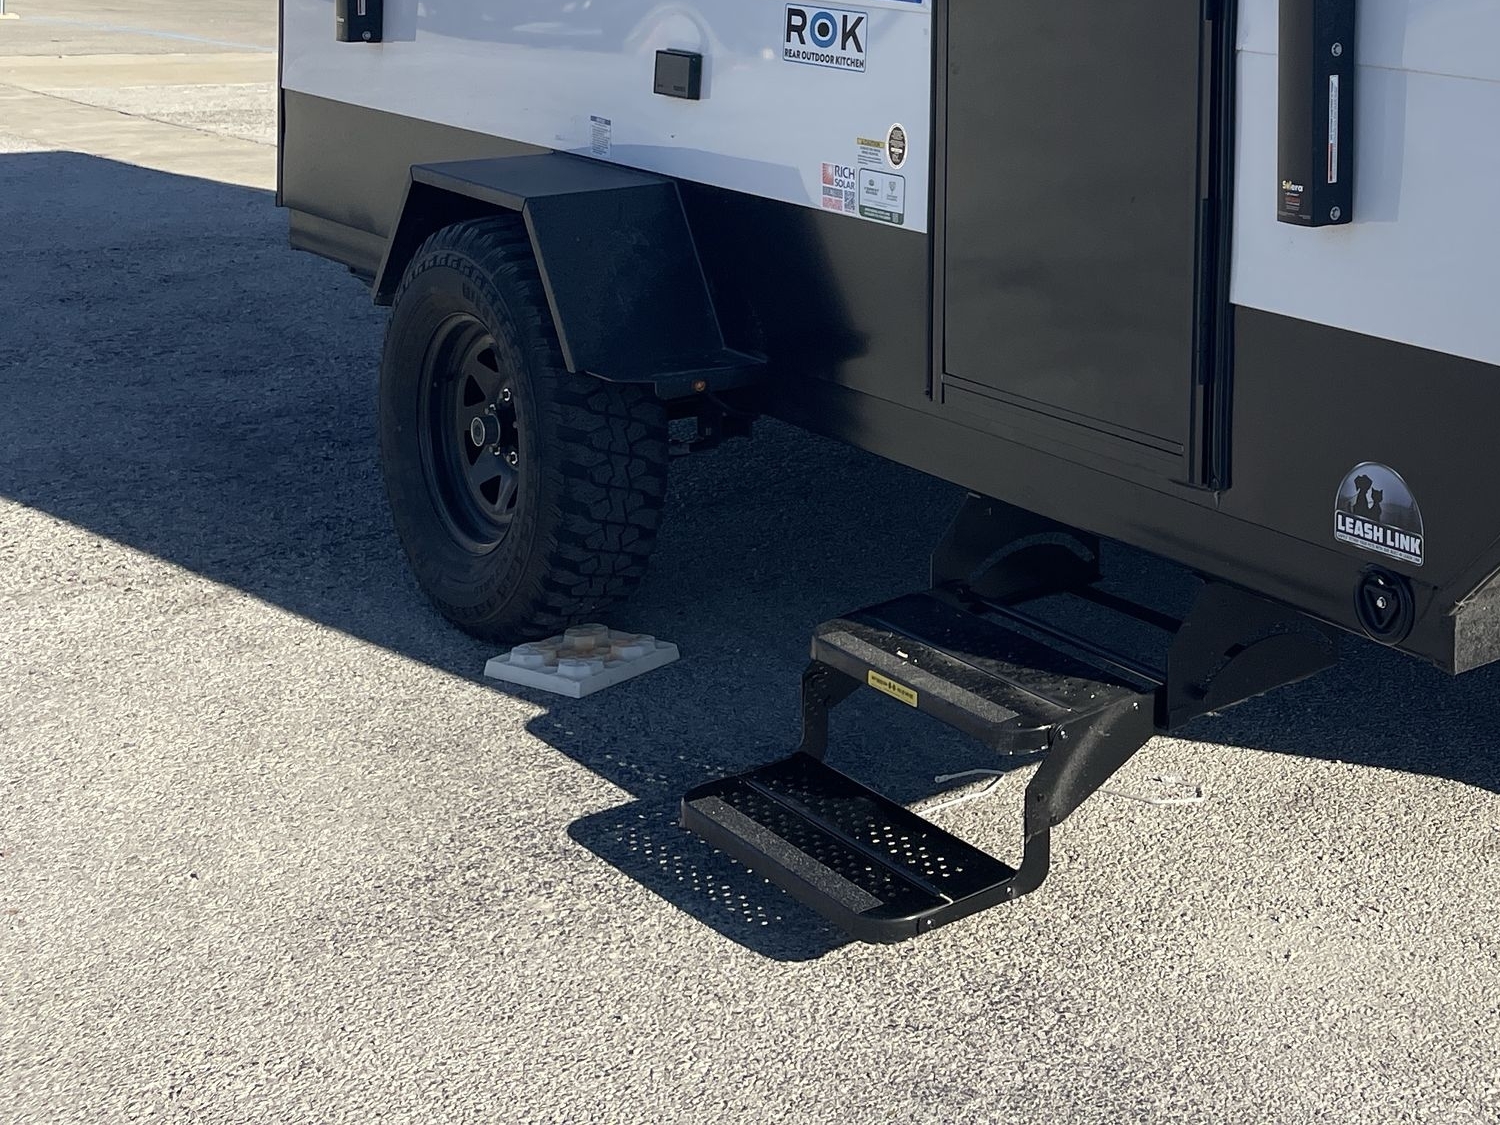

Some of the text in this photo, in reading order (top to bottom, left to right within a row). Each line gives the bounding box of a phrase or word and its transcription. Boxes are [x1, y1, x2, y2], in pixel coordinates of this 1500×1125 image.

[785, 7, 865, 53] ROK
[784, 48, 865, 68] REAR OUTDOOR KITCHEN
[834, 165, 856, 180] RICH
[834, 178, 856, 190] SOLAR
[1337, 514, 1384, 543] LEASH
[1386, 529, 1421, 555] LINK
